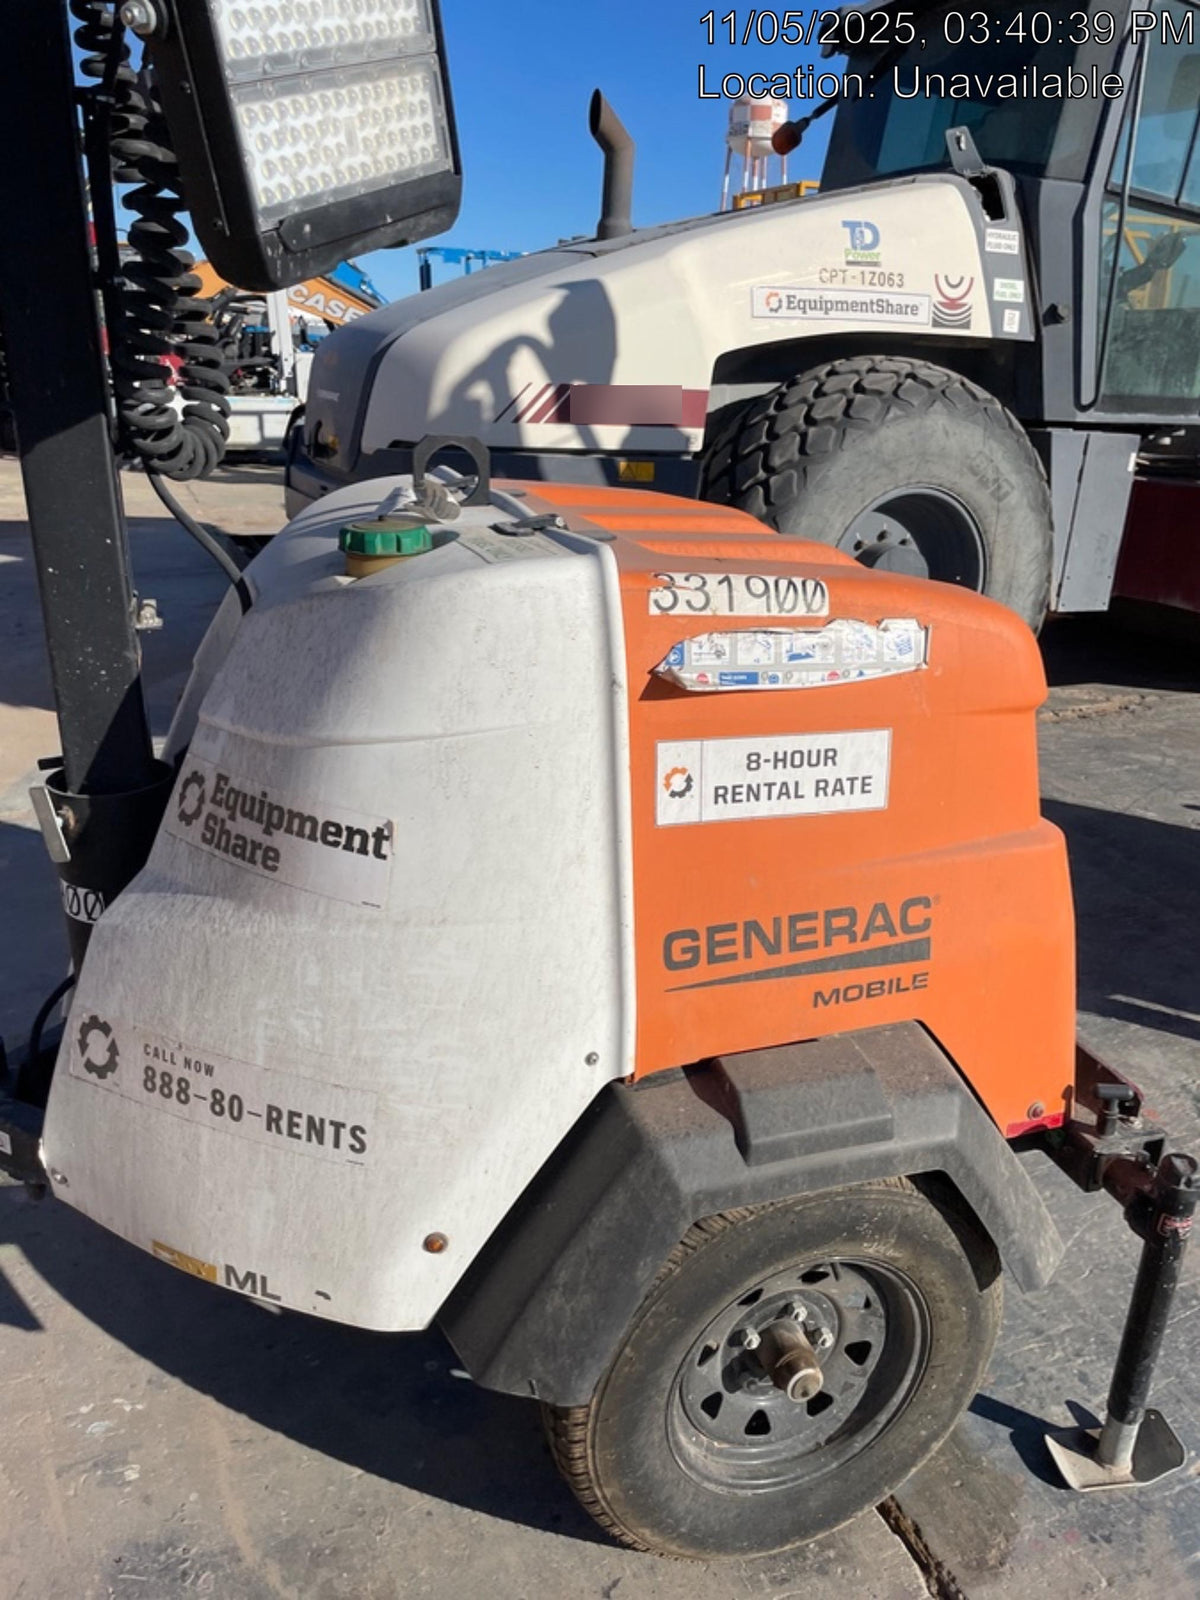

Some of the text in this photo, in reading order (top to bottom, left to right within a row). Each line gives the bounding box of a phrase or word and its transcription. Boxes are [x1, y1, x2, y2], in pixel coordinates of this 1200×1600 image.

[785, 294, 919, 317] EquipmentShare
[652, 572, 827, 613] 331900
[745, 748, 839, 772] 8-HOUR
[713, 776, 873, 806] RENTAL RATE
[209, 773, 391, 861] Equipment
[201, 812, 281, 873] Share
[662, 895, 932, 971] GENERAC
[812, 972, 930, 1009] MOBILE
[143, 1043, 215, 1078] CALL NOW
[143, 1065, 367, 1155] 888-80-RENTS
